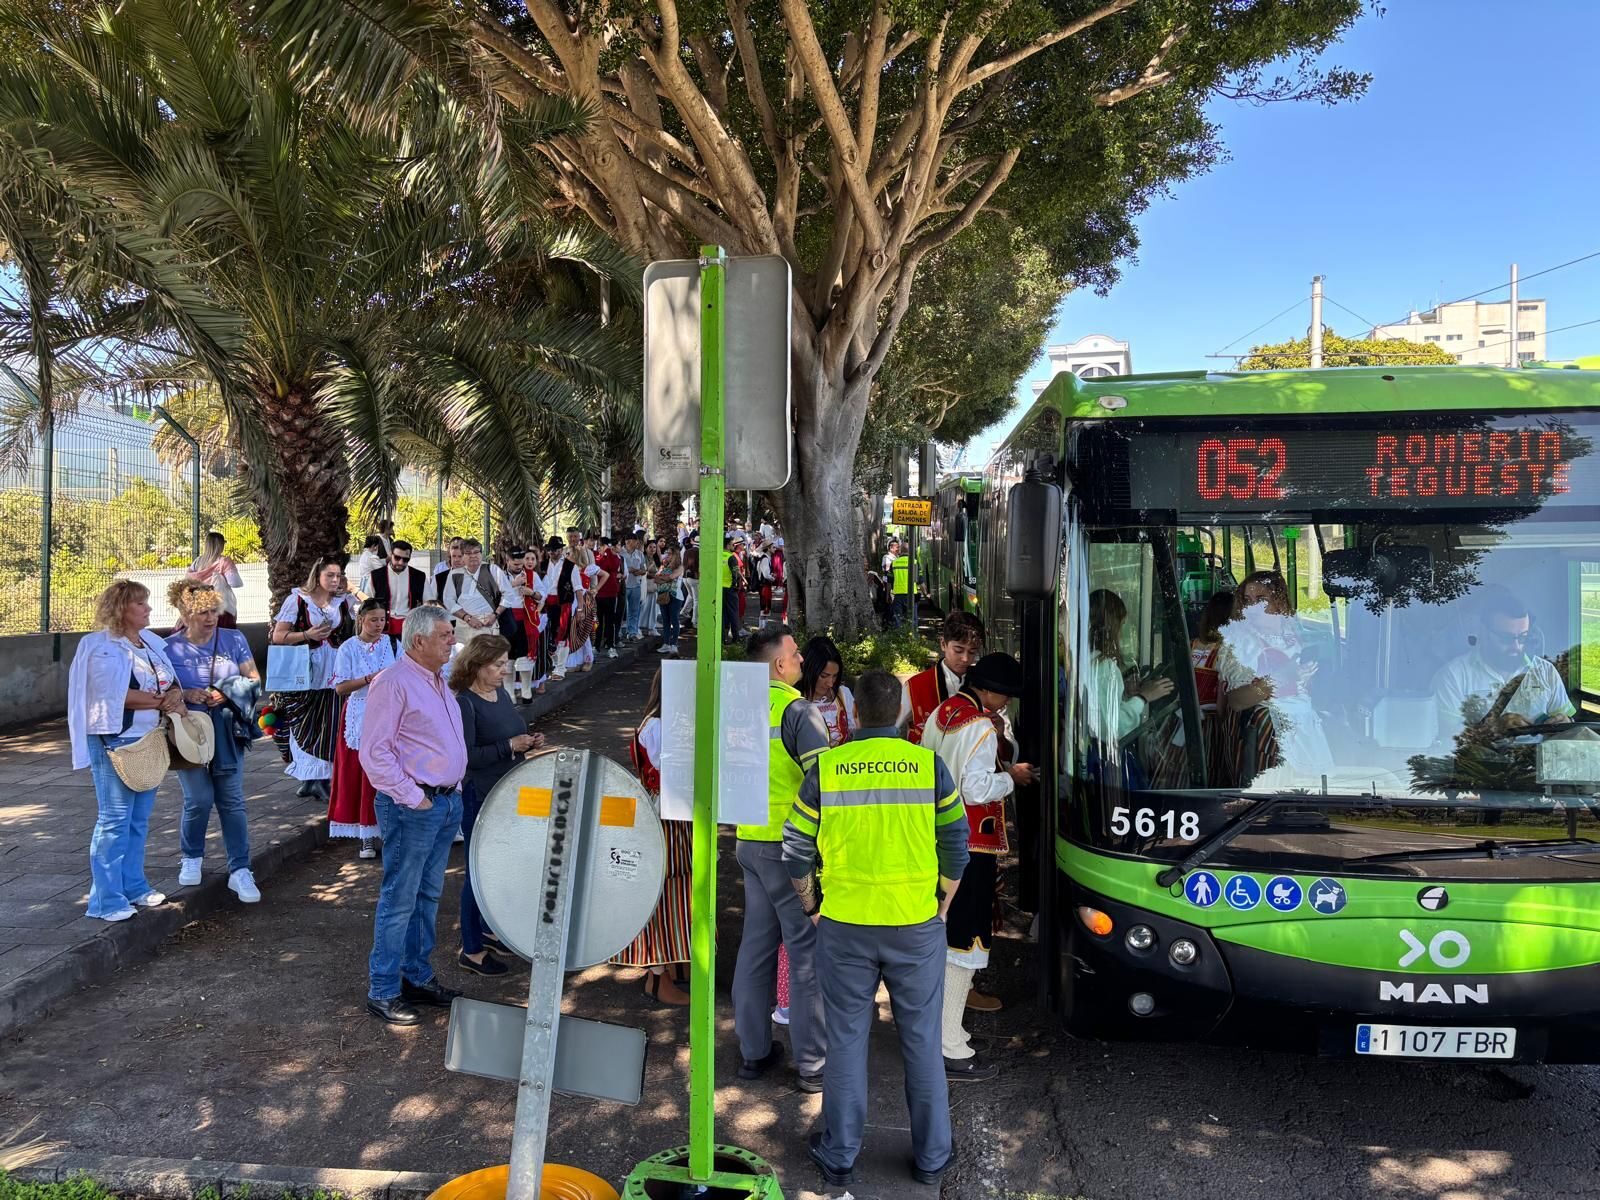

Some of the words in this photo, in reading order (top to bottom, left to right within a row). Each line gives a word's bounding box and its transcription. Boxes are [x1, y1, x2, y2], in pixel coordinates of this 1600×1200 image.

[1376, 431, 1562, 465] ROMERIA
[1198, 438, 1287, 499] 052
[1365, 463, 1572, 498] TEGUESTE
[835, 759, 920, 776] INSPECCIÓN
[1110, 806, 1200, 841] 5618
[1379, 980, 1489, 1004] MAN
[1381, 1029, 1447, 1053] 1107
[1456, 1032, 1508, 1054] FBR
